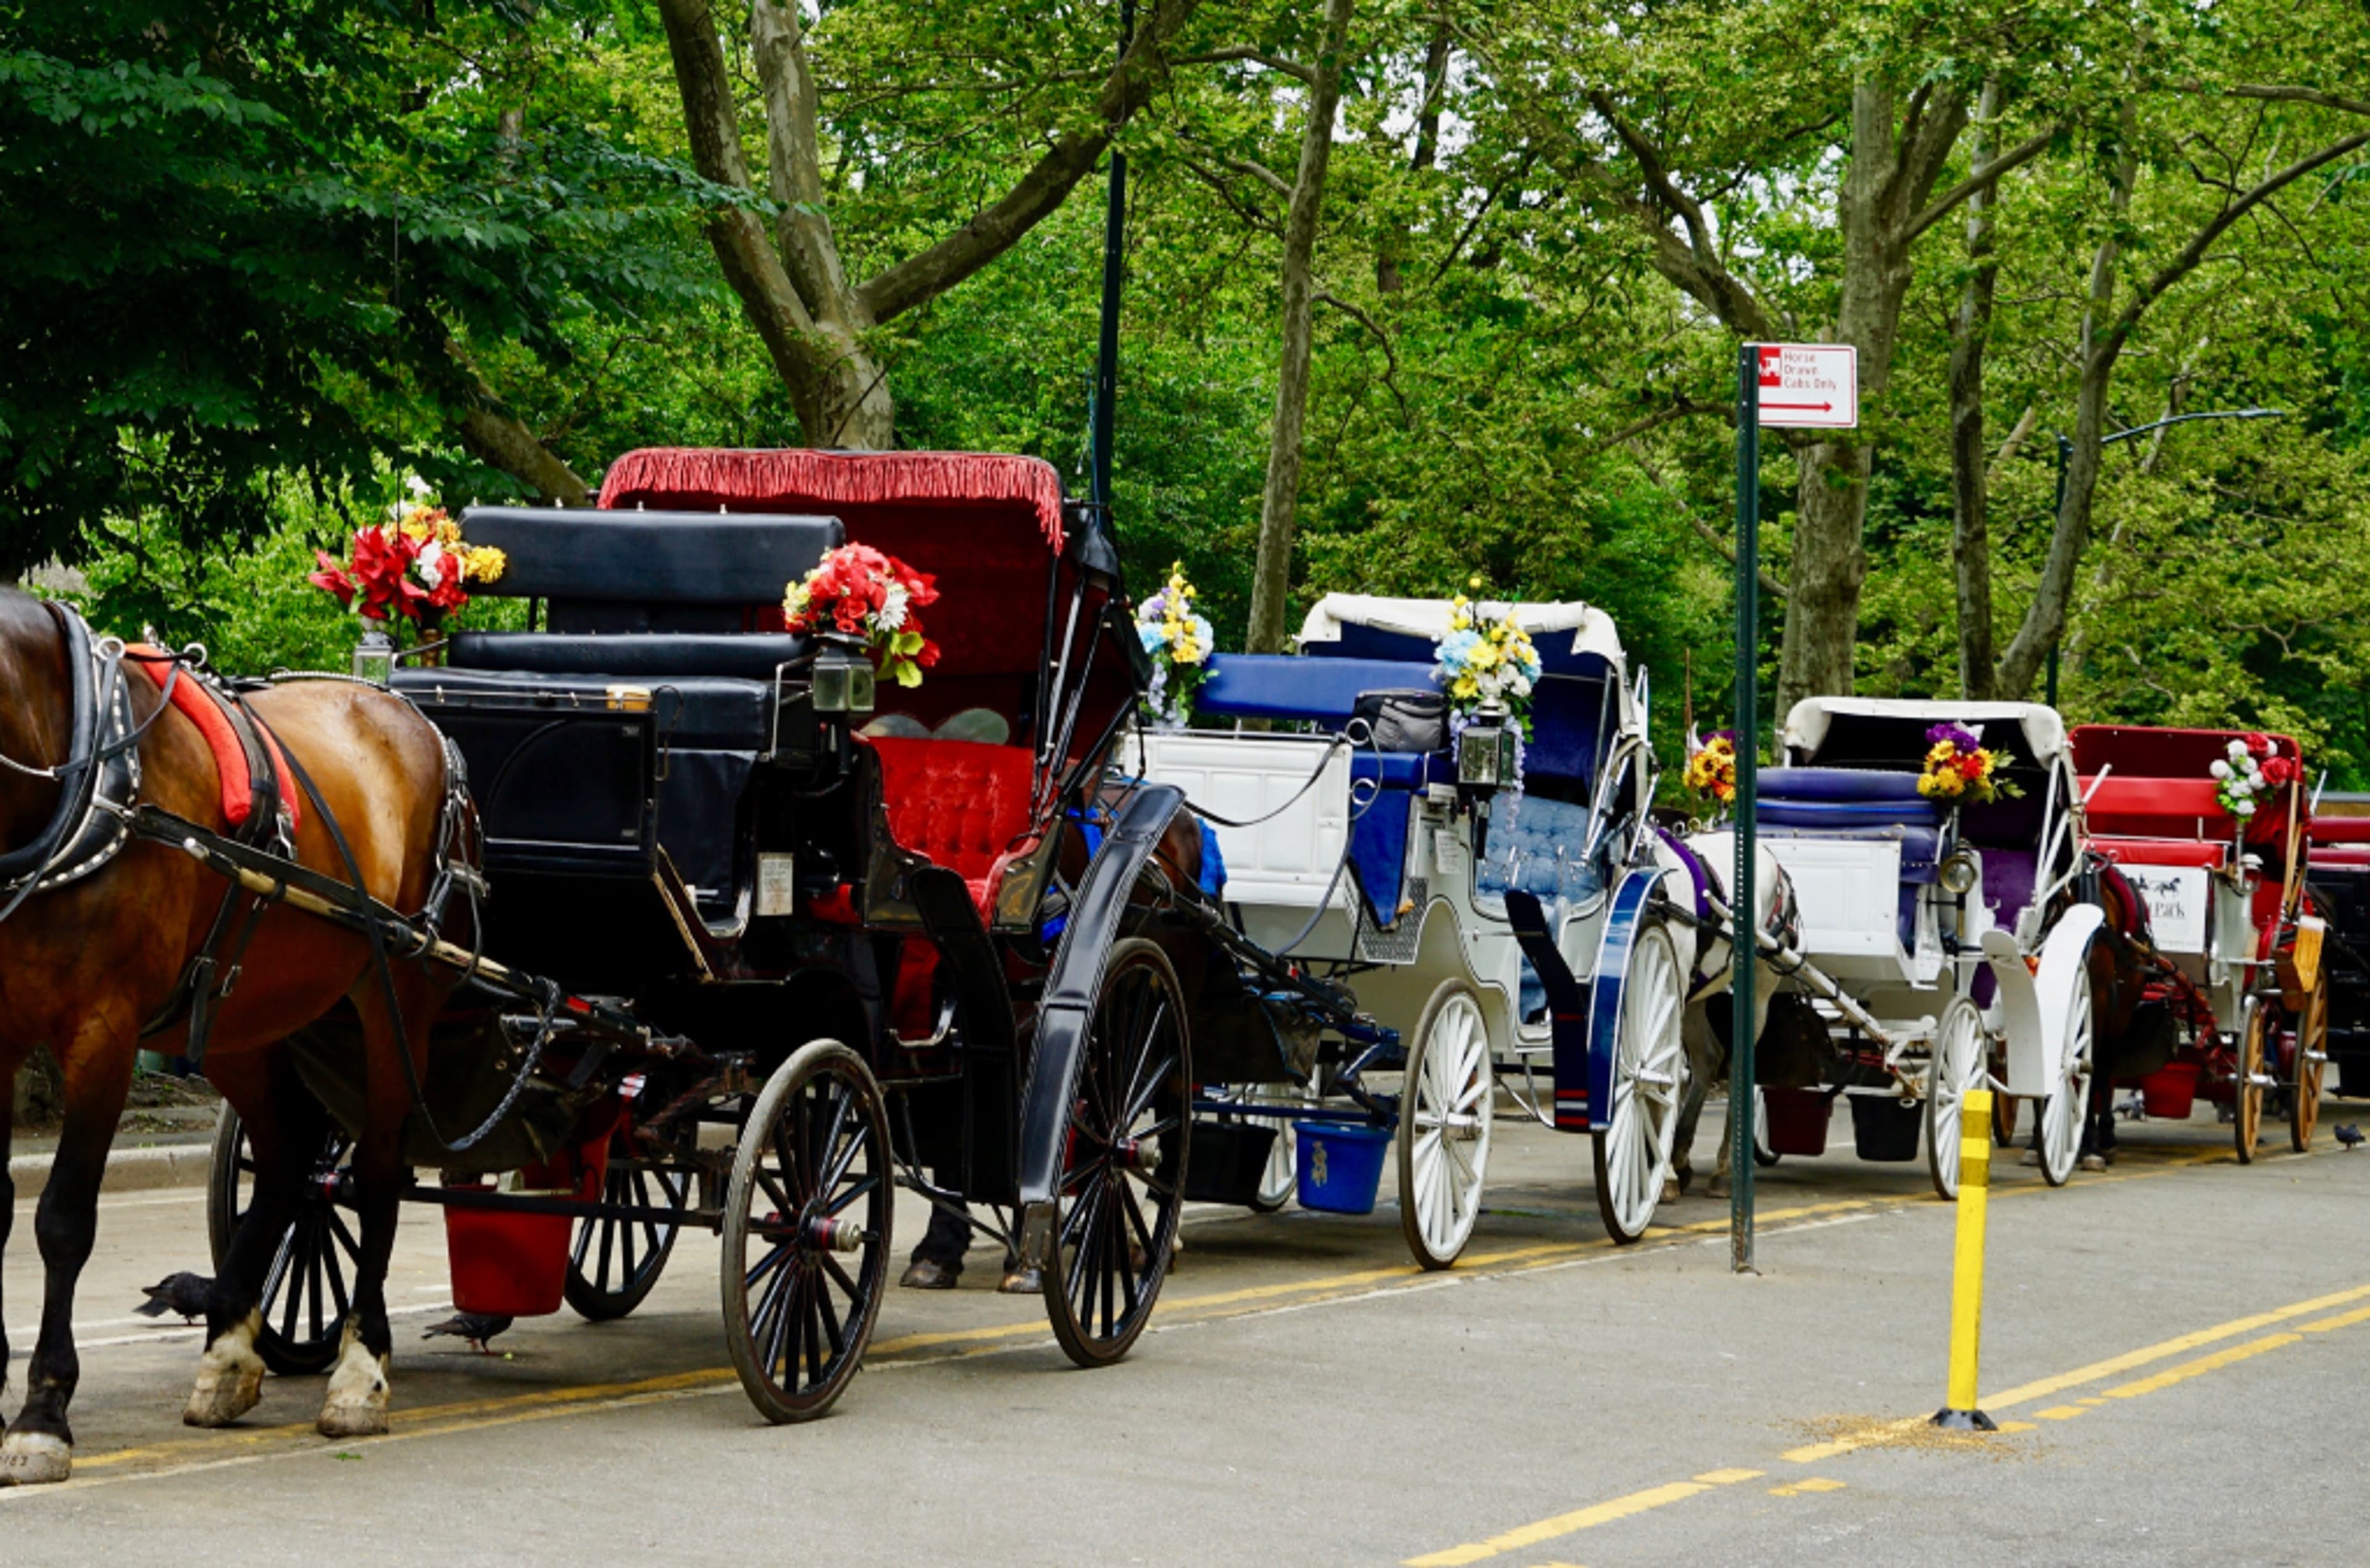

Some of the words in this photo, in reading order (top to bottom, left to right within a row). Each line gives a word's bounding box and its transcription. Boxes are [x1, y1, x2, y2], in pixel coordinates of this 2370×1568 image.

[1784, 352, 1816, 363] Horse
[1784, 365, 1818, 375] Drawn
[1784, 378, 1811, 389] Cabs
[1814, 378, 1837, 391] Only
[2155, 901, 2185, 918] Park
